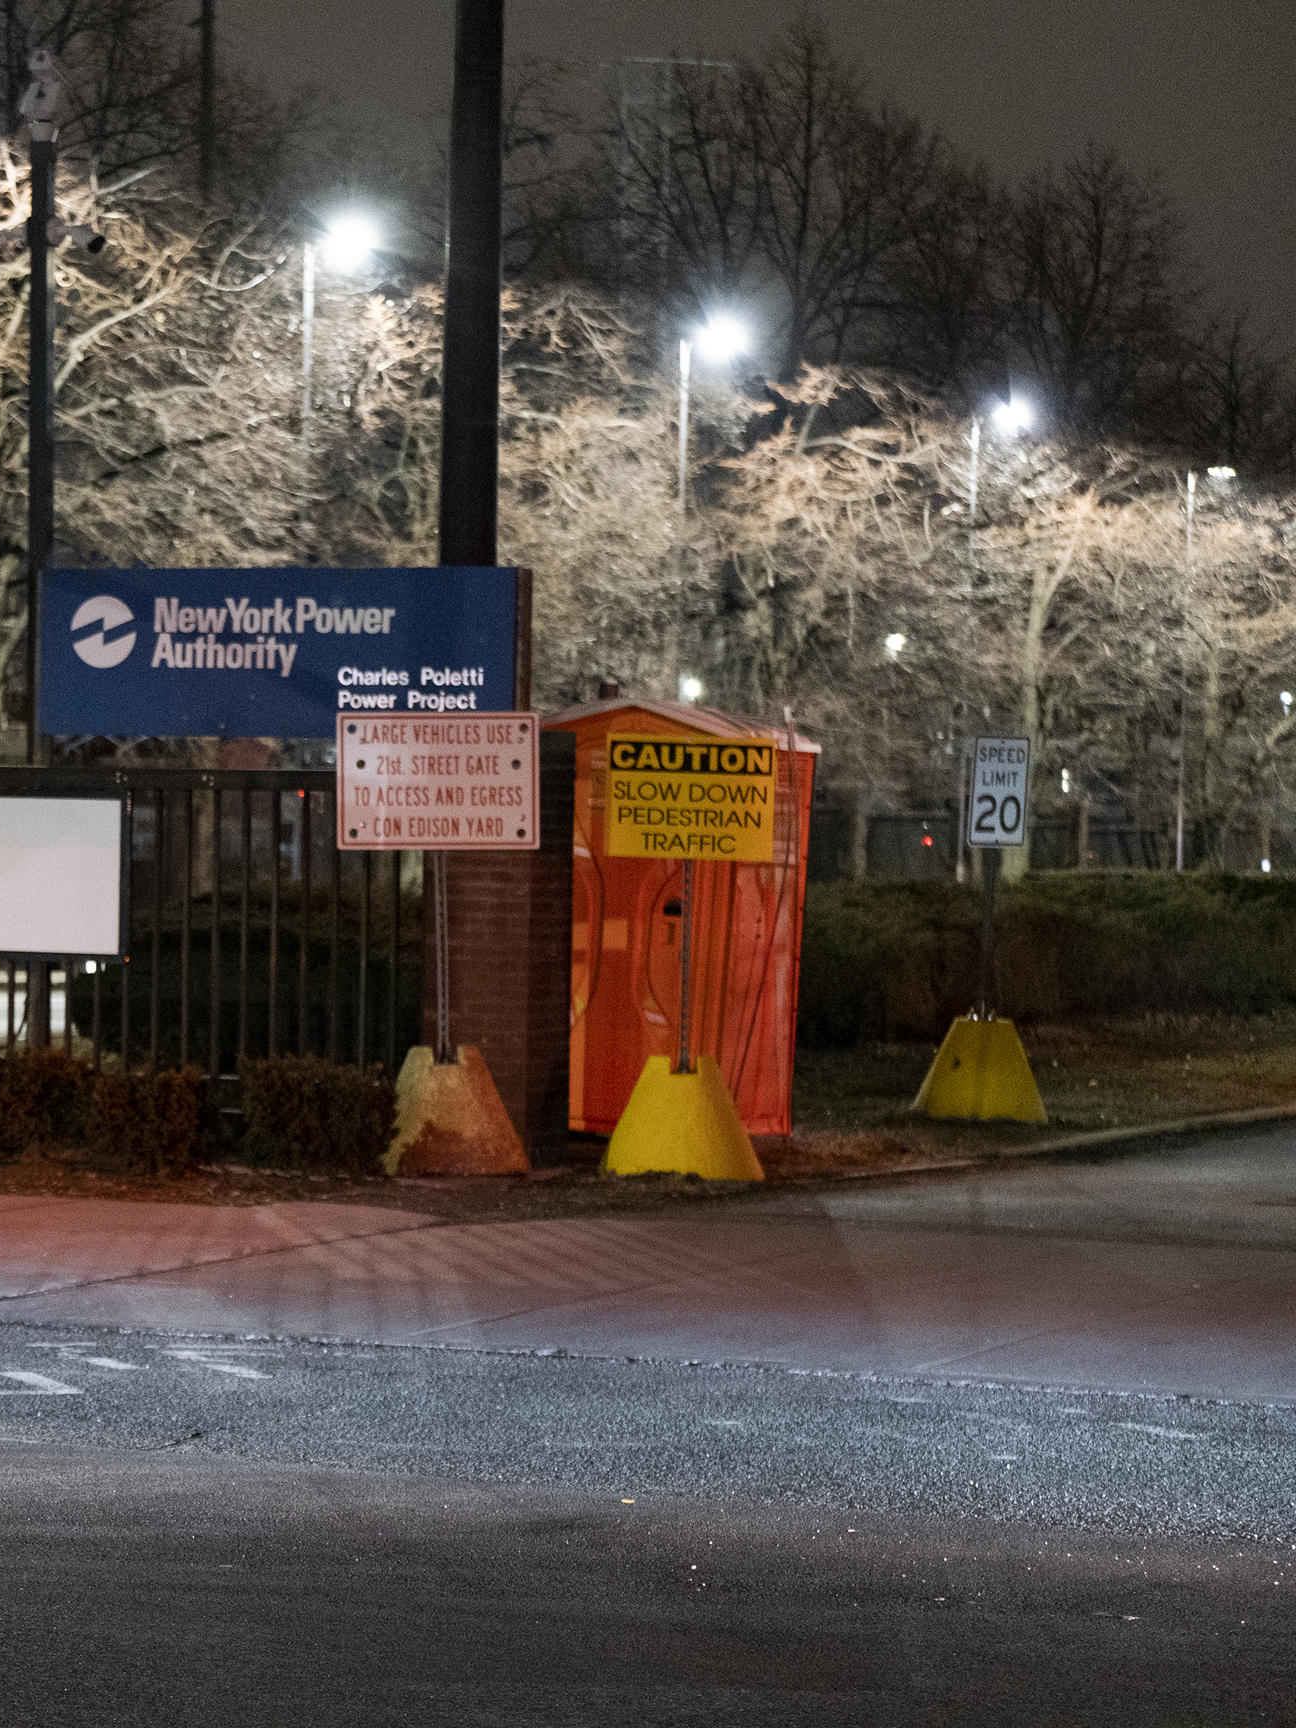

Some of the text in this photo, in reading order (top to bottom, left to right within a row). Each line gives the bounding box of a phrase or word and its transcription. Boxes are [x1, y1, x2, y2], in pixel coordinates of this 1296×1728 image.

[295, 597, 396, 634] Power
[151, 633, 298, 678] Authority
[337, 666, 484, 686] Charles Poletti
[338, 690, 477, 712] Power Project
[360, 724, 513, 745] LARGE VEHICLES USE
[376, 755, 501, 776] 21st STREET GATE
[612, 743, 771, 773] CAUTION
[979, 746, 1025, 765] SPEED
[982, 770, 1019, 788] LIMIT
[354, 786, 524, 807] TO ACCESS AND EGRESS
[613, 781, 768, 805] SLOW DOWN
[618, 807, 762, 829] PEDESTRIAN
[975, 795, 1021, 835] 20
[373, 817, 504, 838] CON EDISON YARD
[641, 832, 736, 854] TRAFFIC
